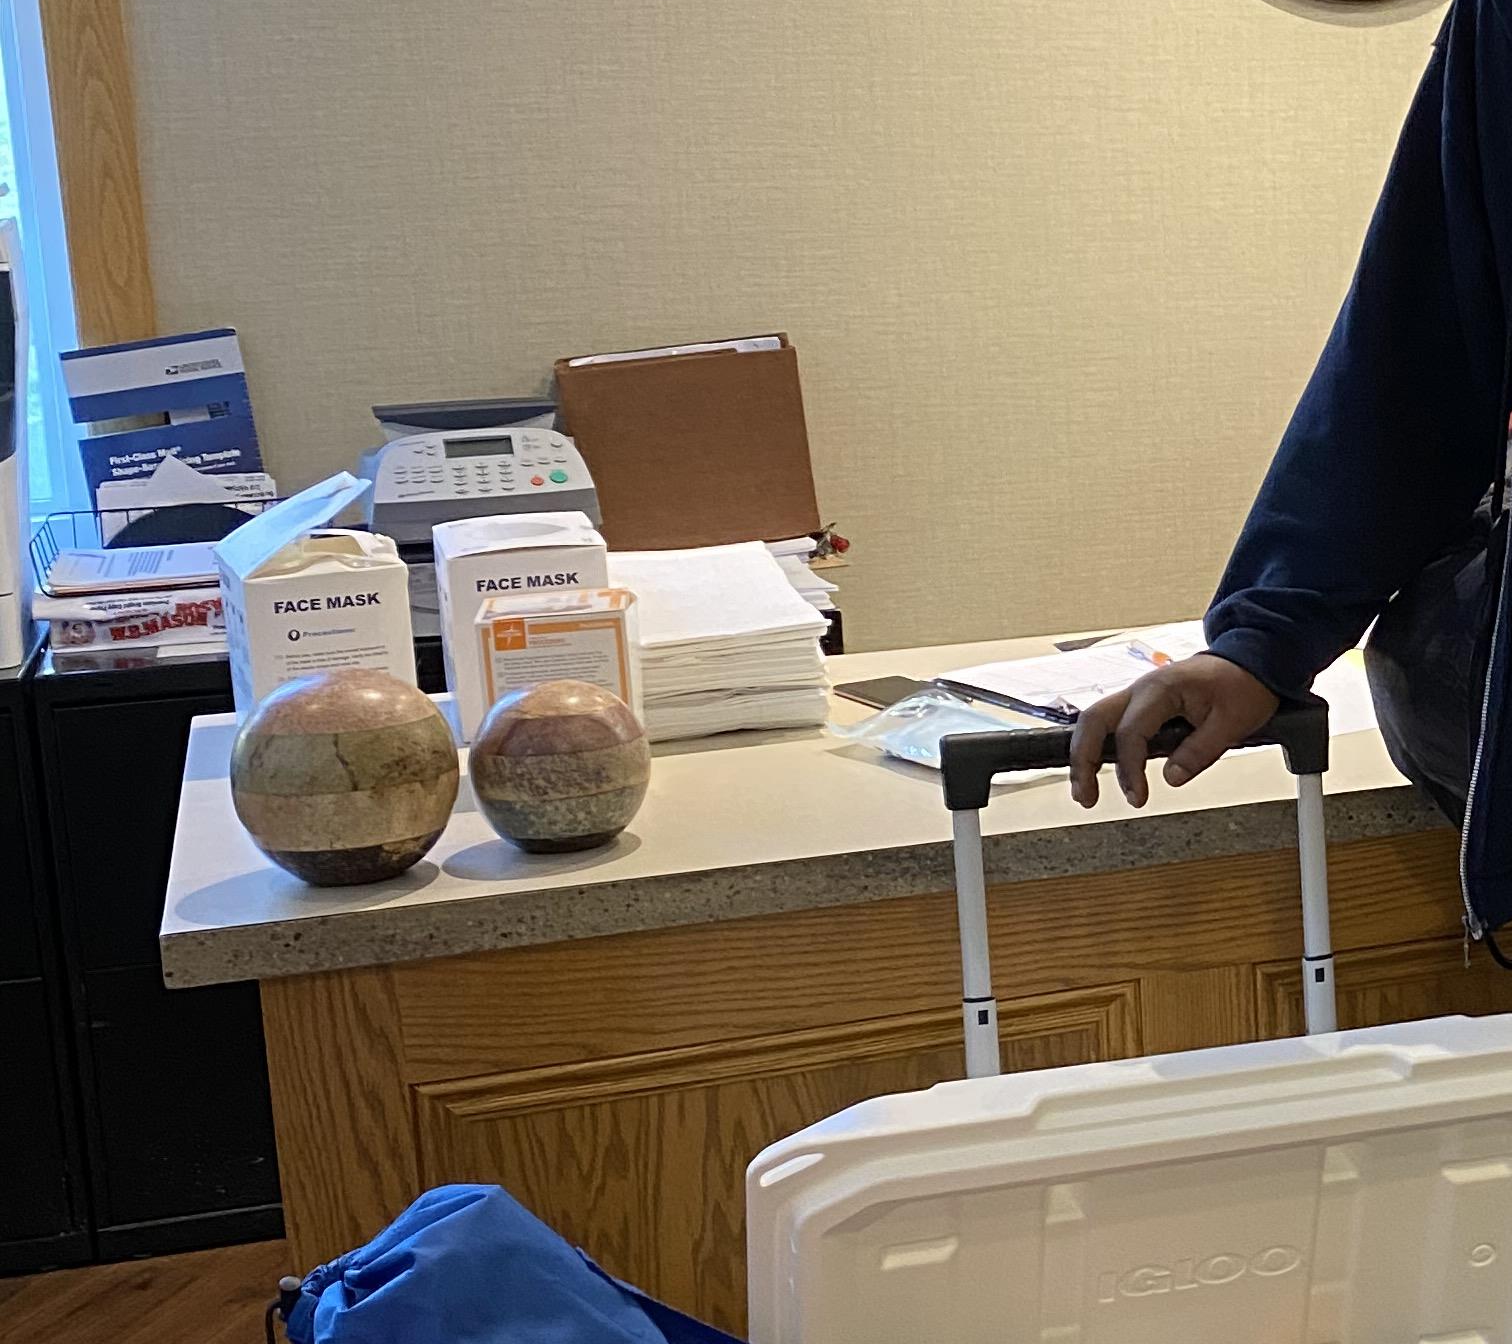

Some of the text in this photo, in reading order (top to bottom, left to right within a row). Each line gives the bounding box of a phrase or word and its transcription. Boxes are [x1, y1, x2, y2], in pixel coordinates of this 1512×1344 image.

[476, 572, 579, 592] FACE MASK
[273, 592, 381, 614] FACE MASK
[1099, 1244, 1301, 1304] IGLOO
